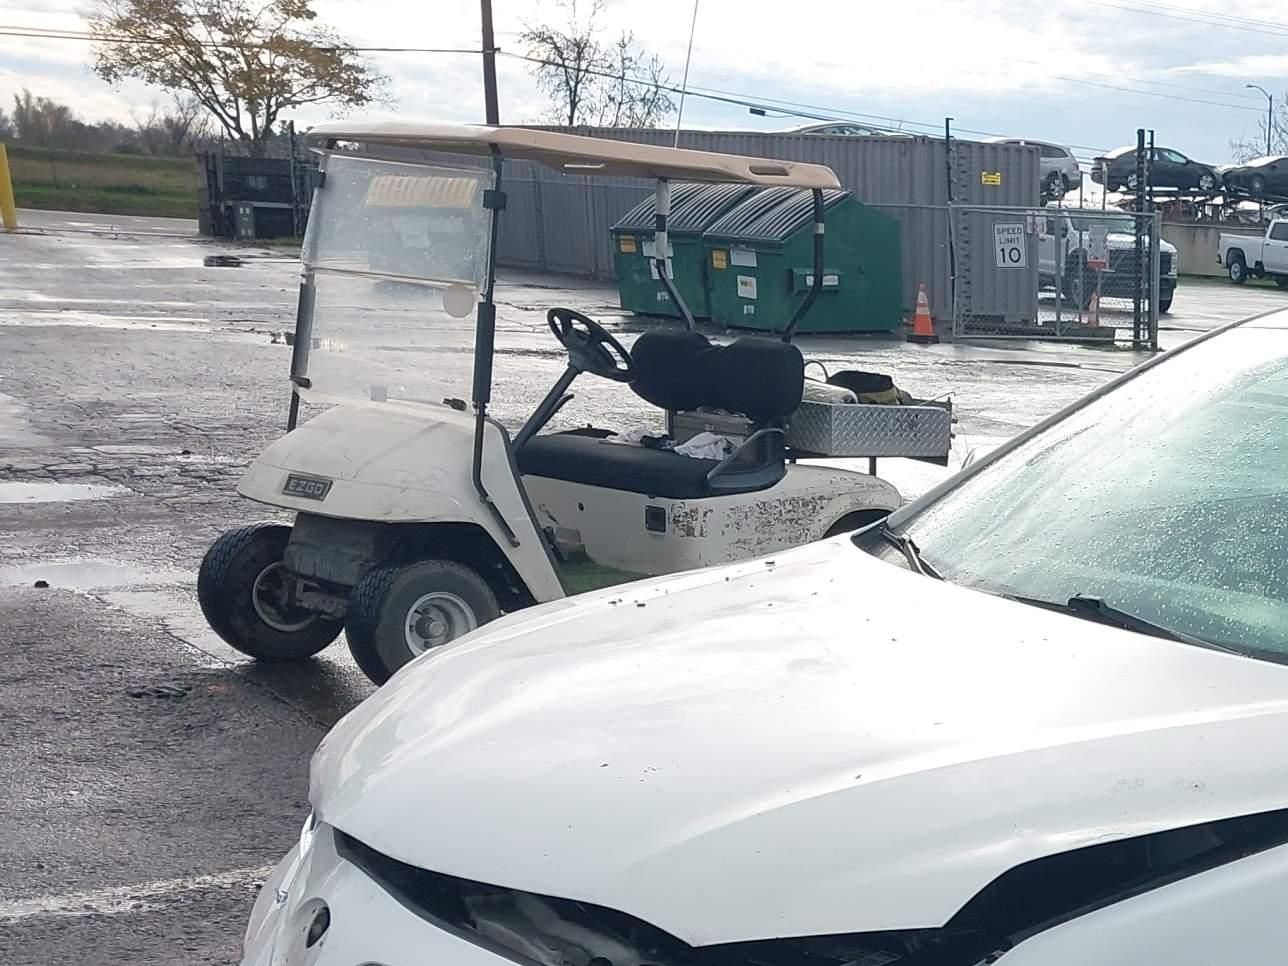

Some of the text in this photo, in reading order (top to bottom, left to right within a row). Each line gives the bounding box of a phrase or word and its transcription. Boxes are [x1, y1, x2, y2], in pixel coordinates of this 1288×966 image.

[996, 226, 1022, 235] SPEED
[999, 237, 1020, 245] LIMIT
[999, 246, 1022, 264] 10
[288, 480, 323, 494] EZGO
